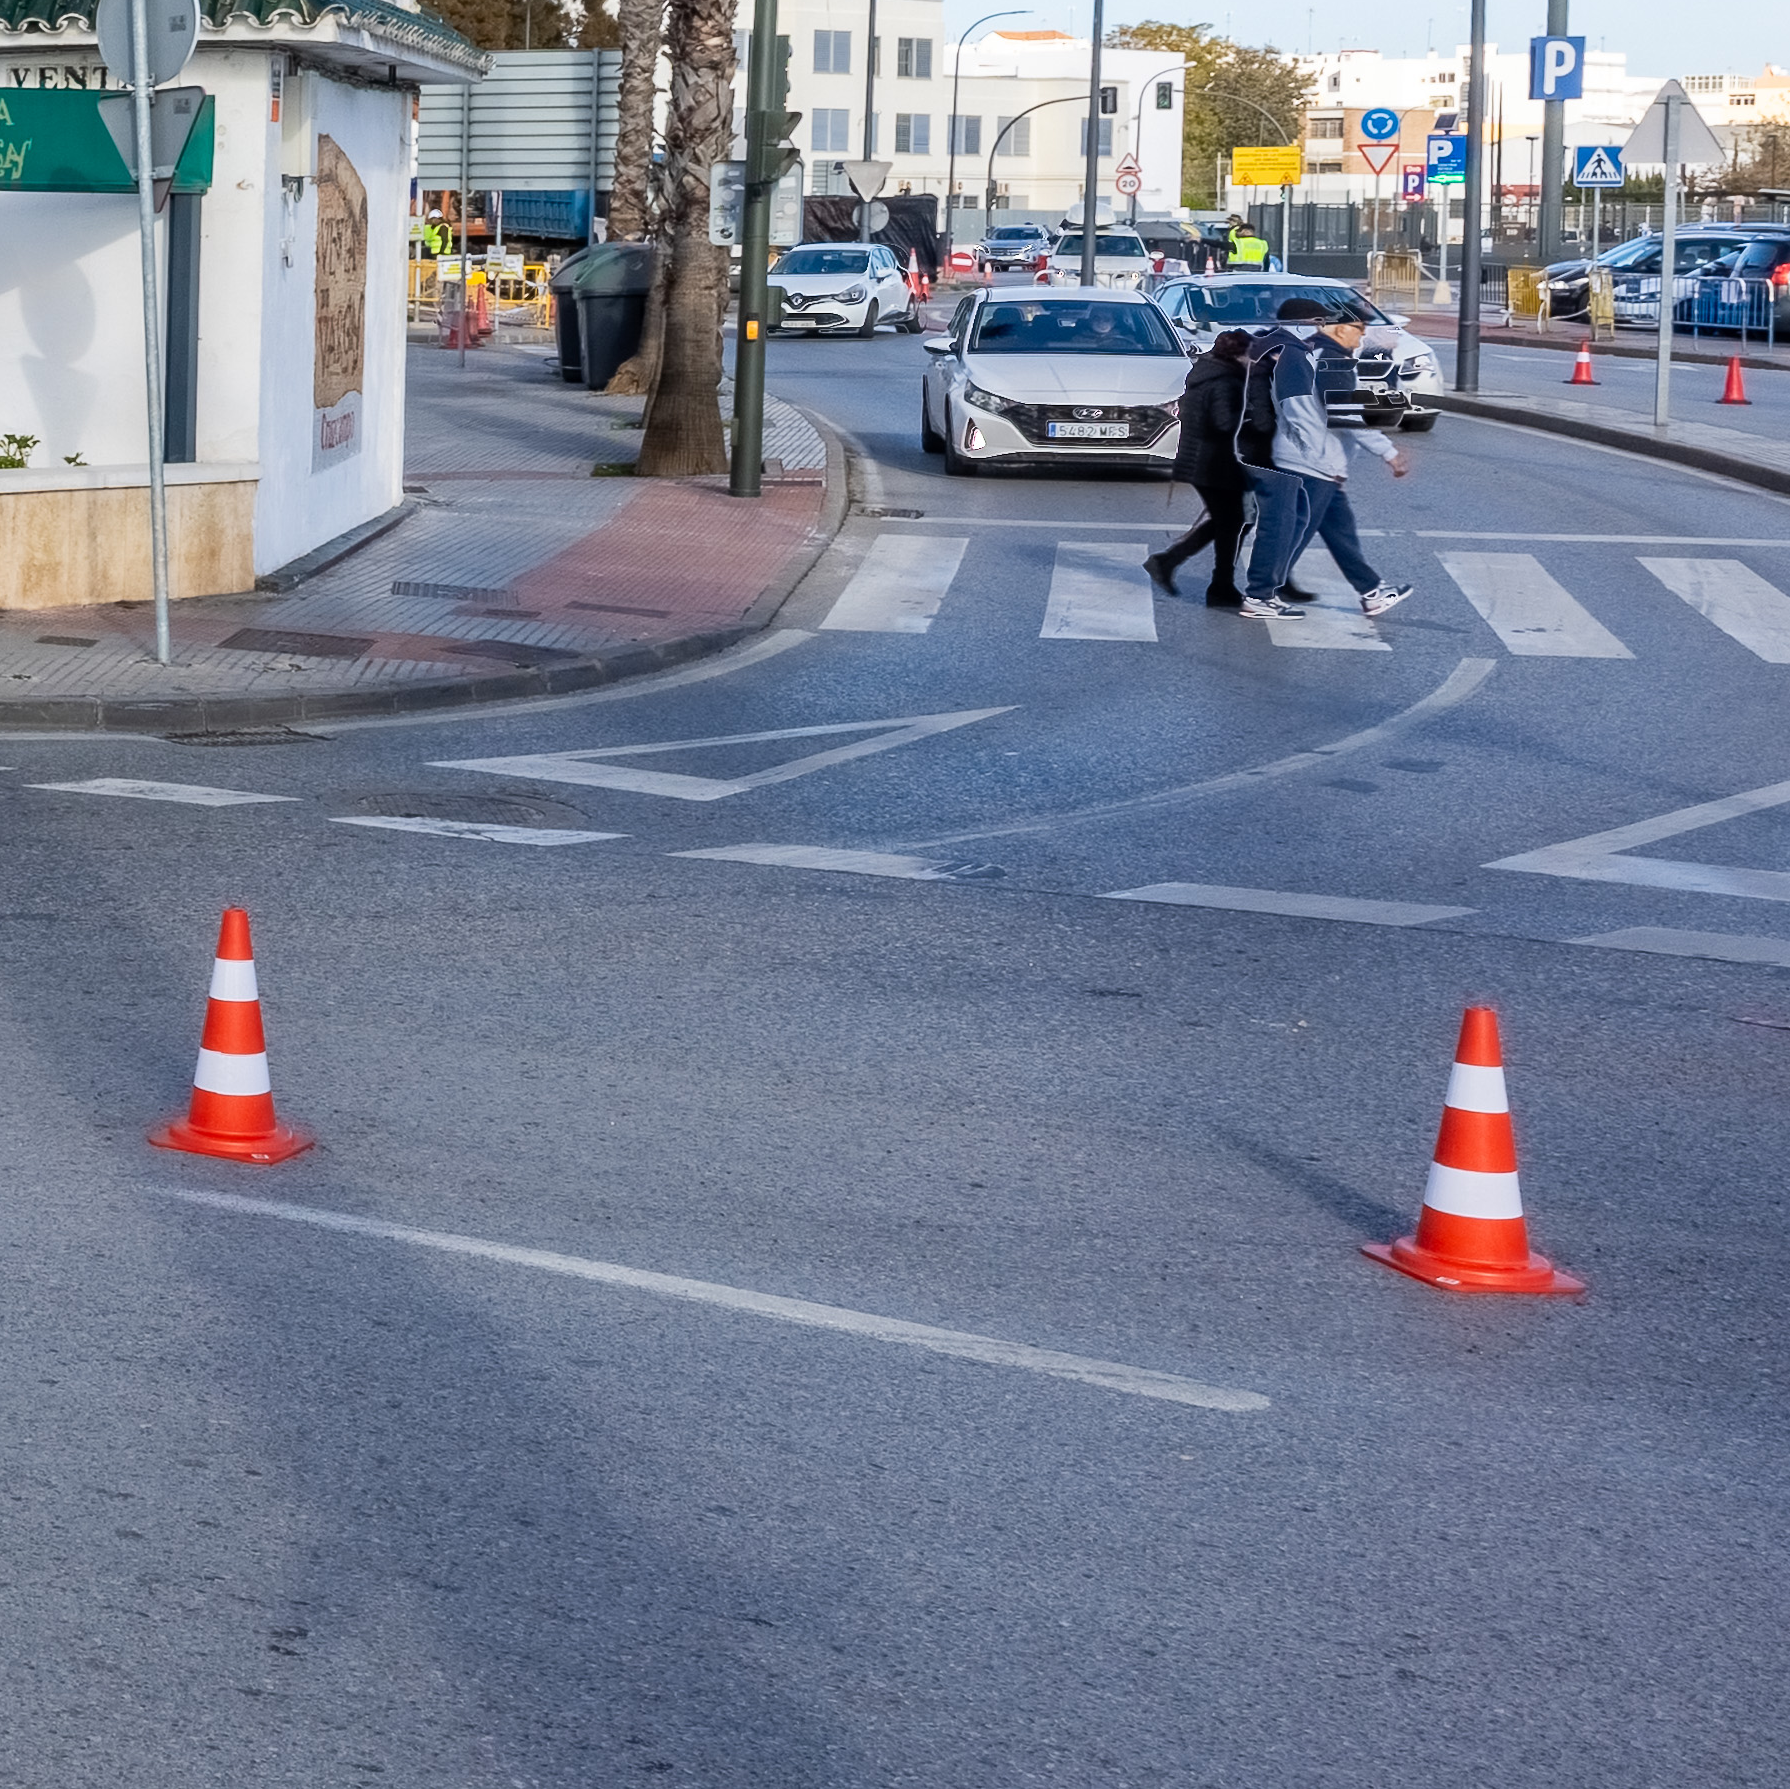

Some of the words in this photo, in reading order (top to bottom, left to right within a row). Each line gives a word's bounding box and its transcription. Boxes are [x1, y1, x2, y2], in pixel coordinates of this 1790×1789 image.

[9, 66, 139, 90] VENT
[1543, 40, 1576, 95] P
[1428, 139, 1454, 166] P
[1122, 180, 1136, 188] 20
[1407, 175, 1420, 193] P
[1059, 425, 1095, 437] 5482
